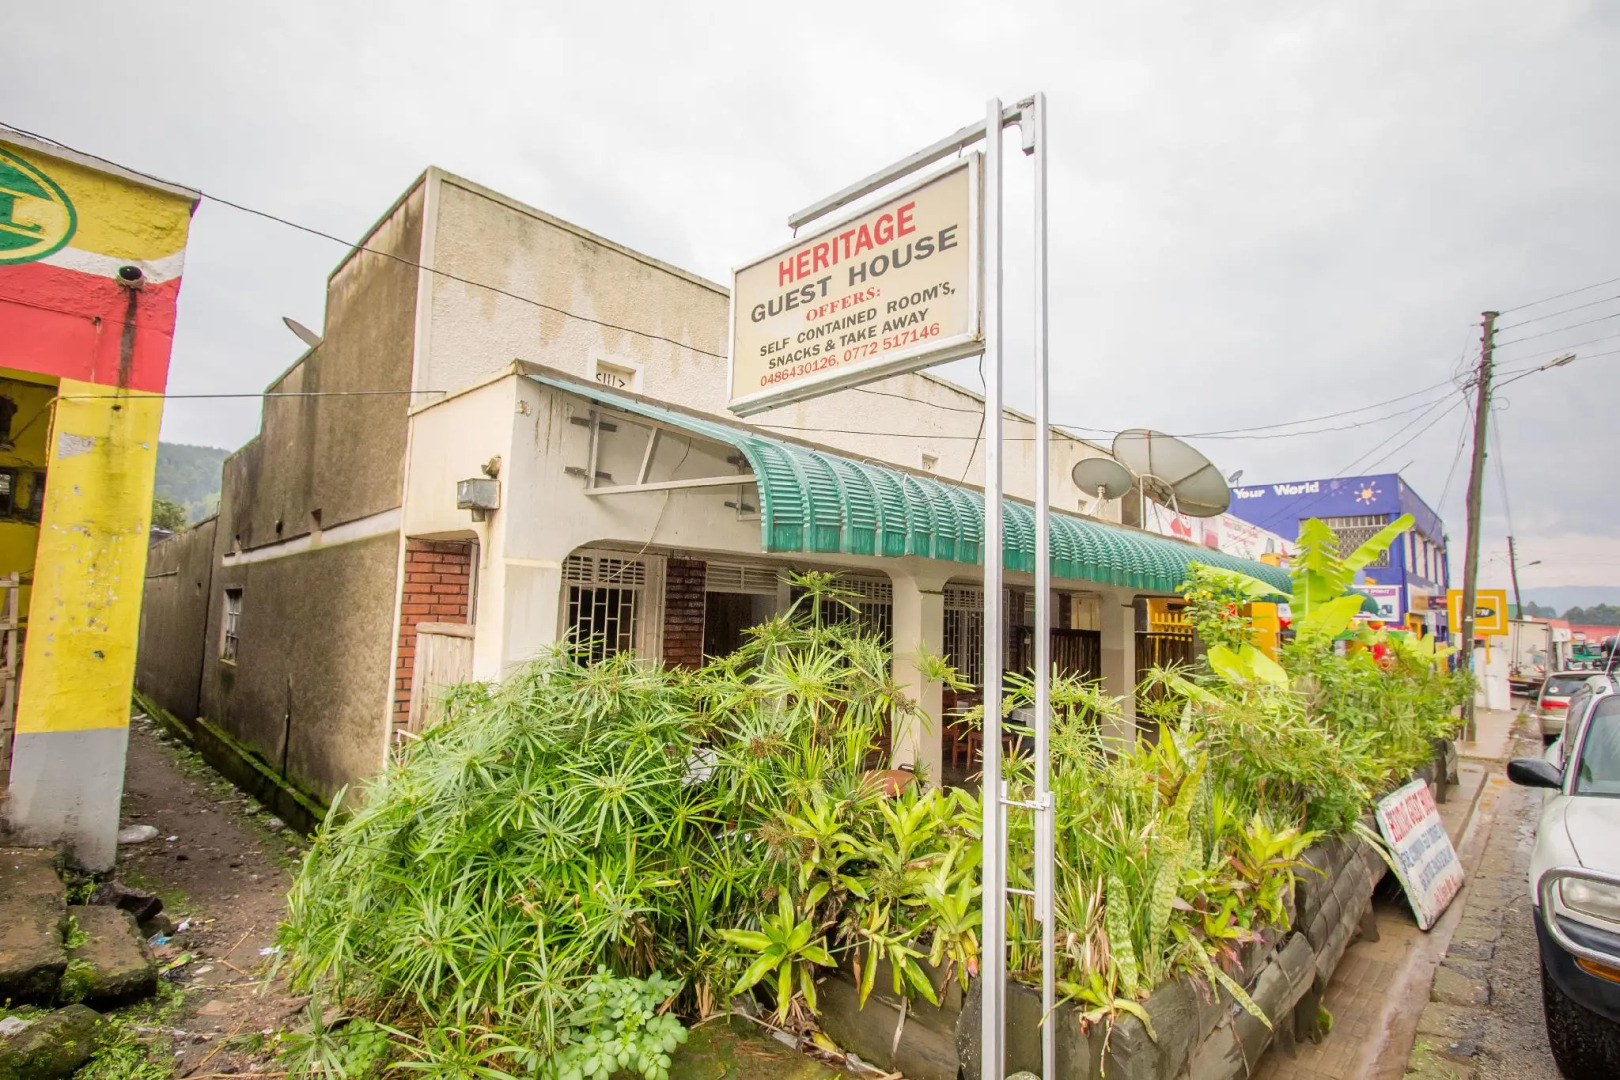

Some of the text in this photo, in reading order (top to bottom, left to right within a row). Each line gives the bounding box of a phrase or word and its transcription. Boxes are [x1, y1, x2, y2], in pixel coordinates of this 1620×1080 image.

[750, 224, 958, 323] GUEST HOUSE
[778, 201, 916, 287] HERITAGE
[760, 281, 956, 357] SELF CONTAINED ROOM'S,
[805, 287, 881, 322] OFFERS:
[760, 322, 940, 387] 0486430126, 0772 517146
[768, 308, 929, 370] SNACKS & TAKE AWAY
[1233, 481, 1320, 500] Your World
